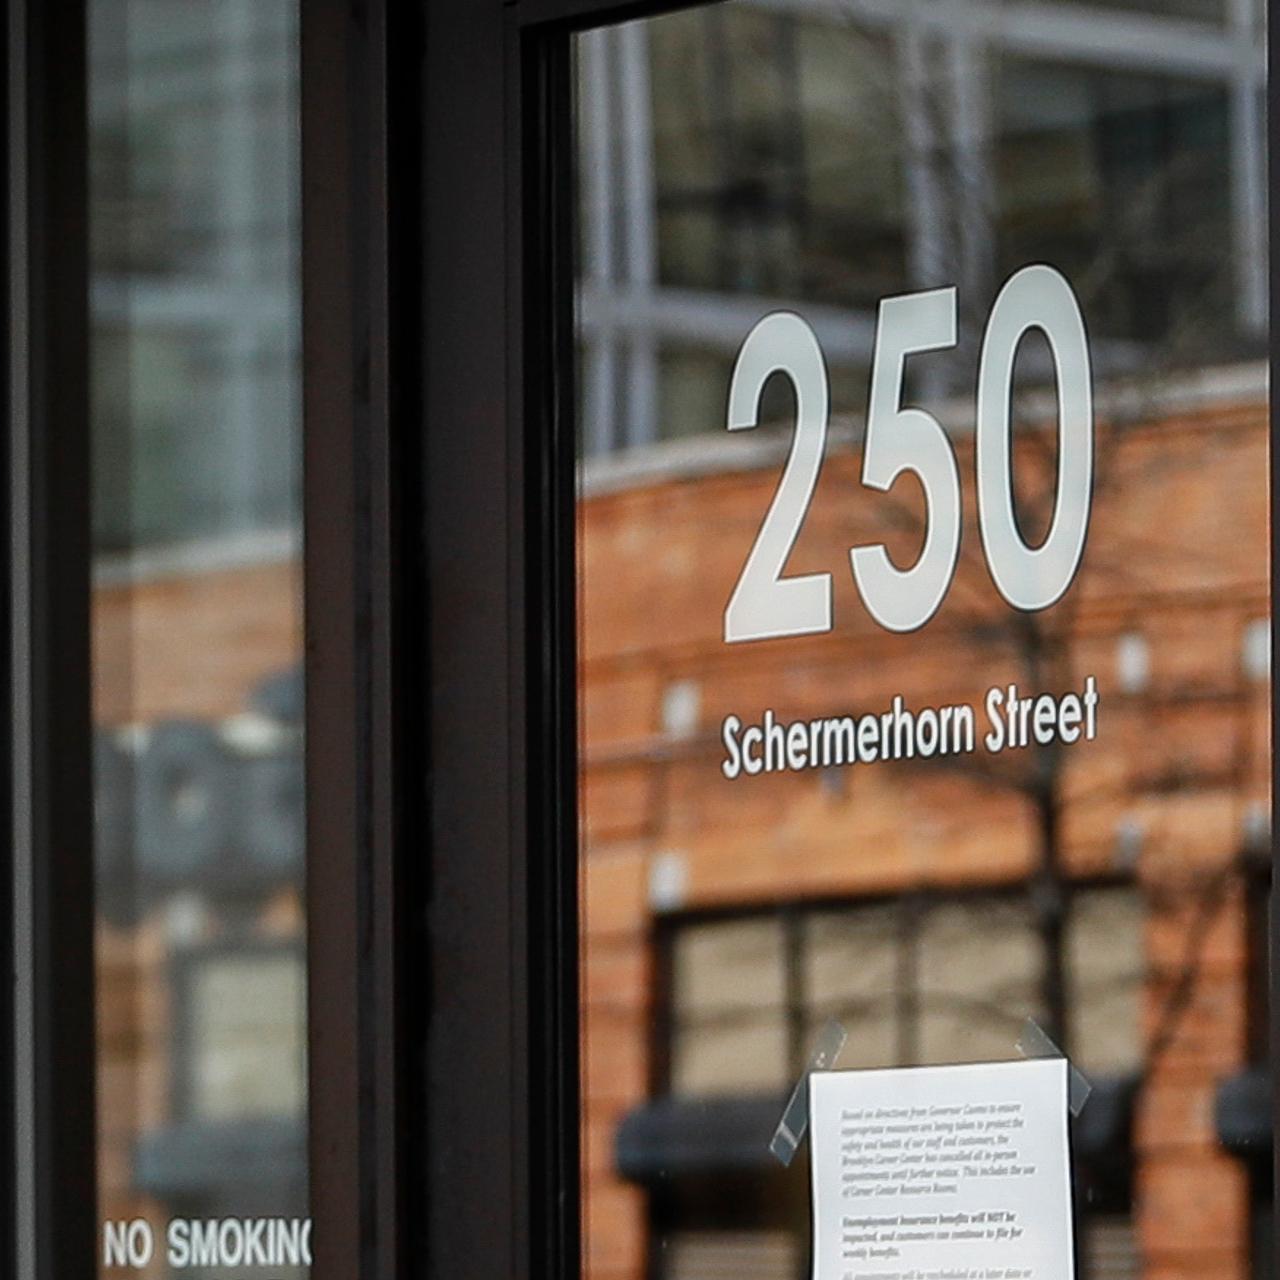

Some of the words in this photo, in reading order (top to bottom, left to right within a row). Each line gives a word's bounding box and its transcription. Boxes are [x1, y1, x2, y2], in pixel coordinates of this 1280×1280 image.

[724, 265, 1093, 643] 250
[723, 697, 973, 778] Schermerhorn
[986, 677, 1098, 752] Street
[104, 1219, 151, 1267] NO
